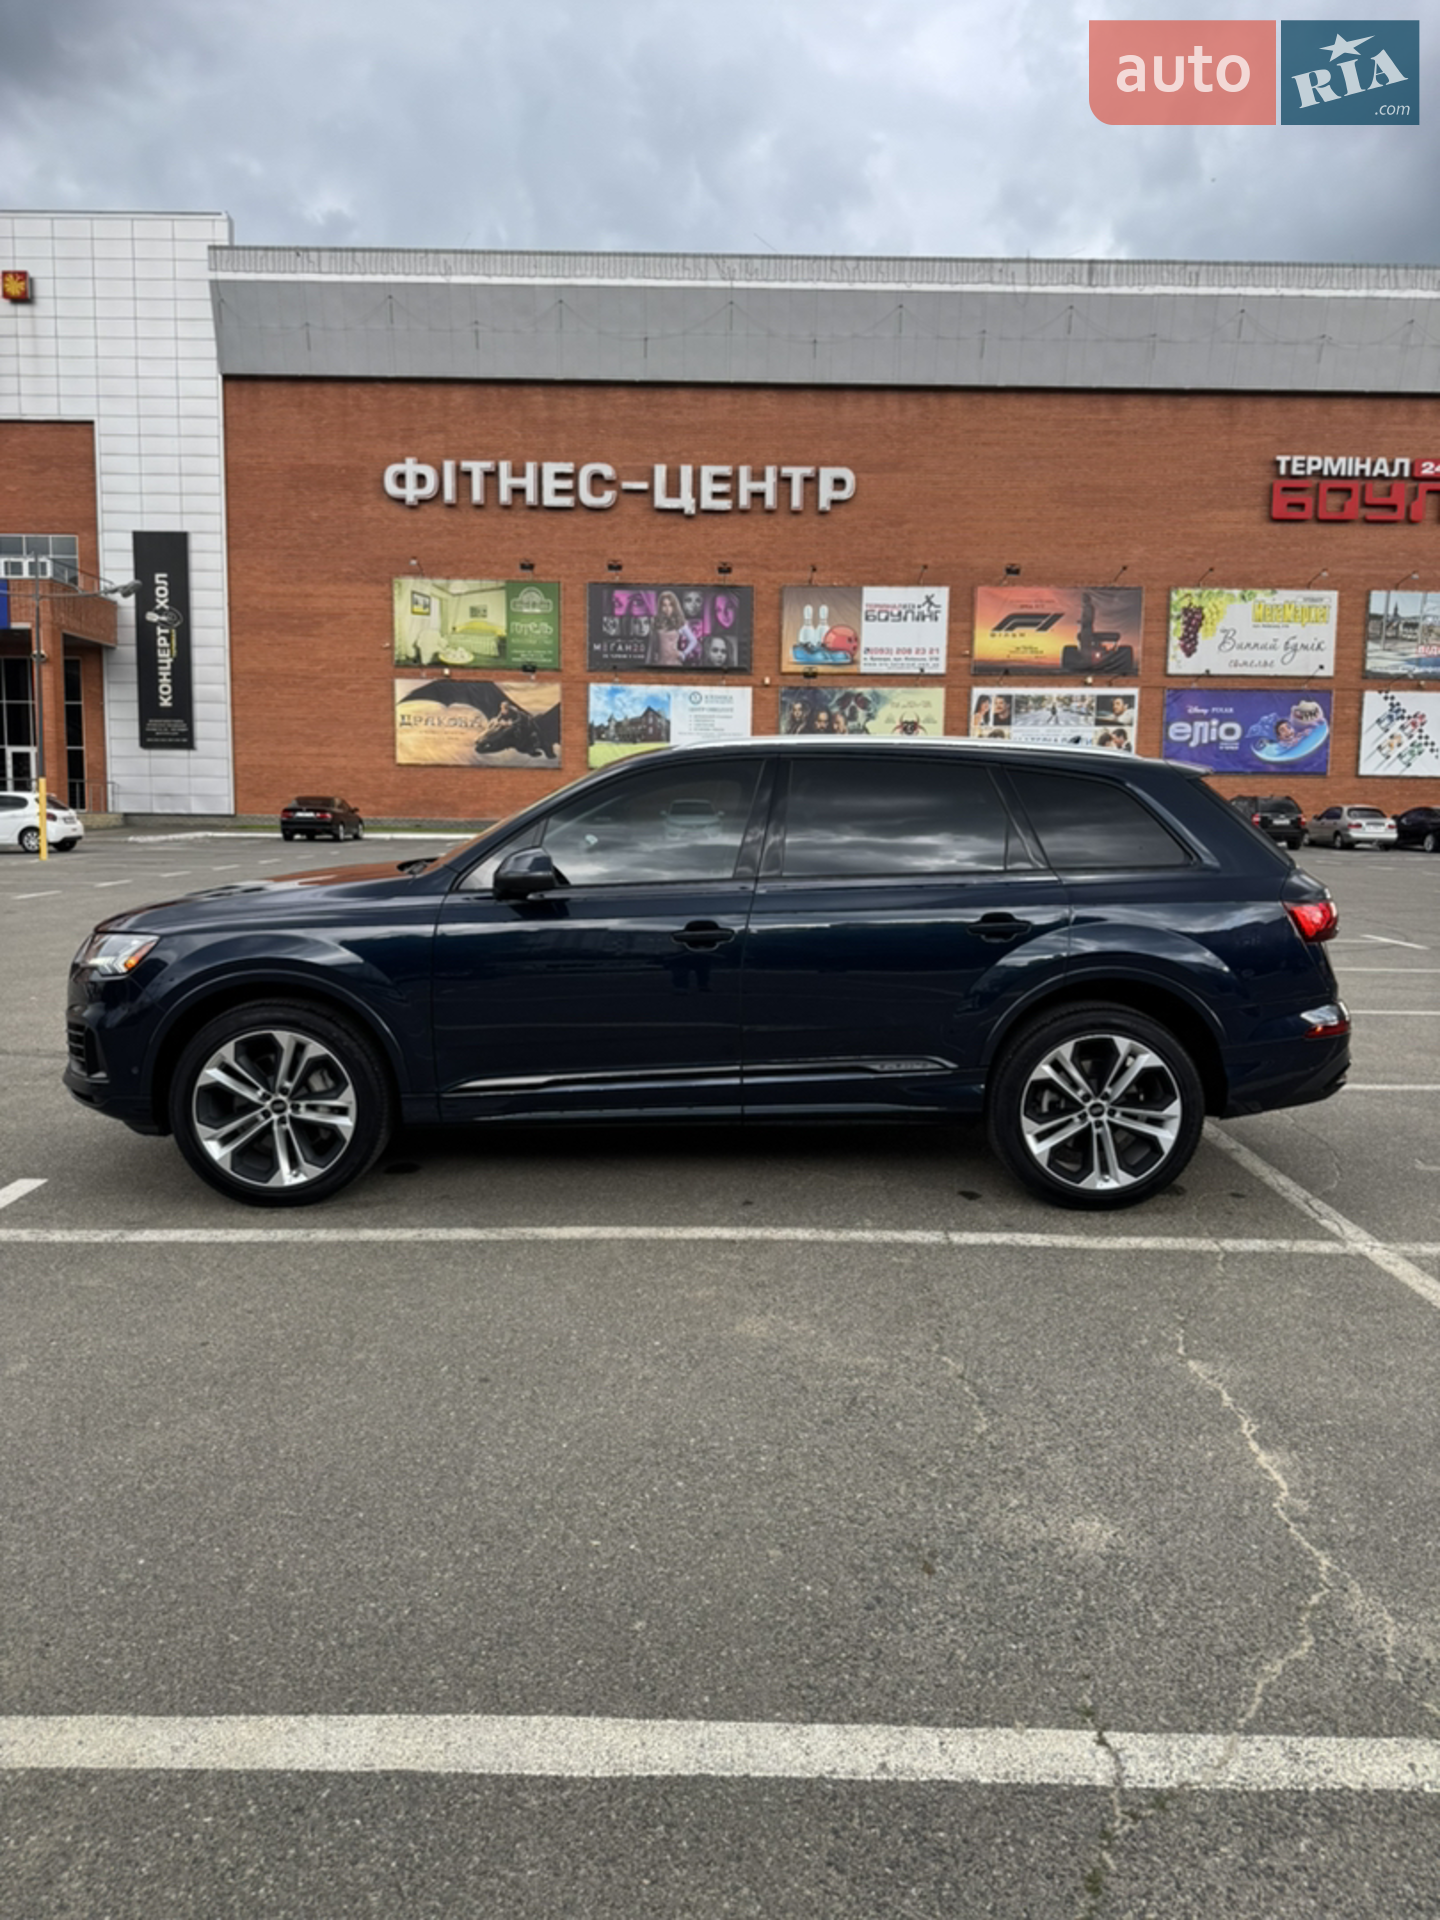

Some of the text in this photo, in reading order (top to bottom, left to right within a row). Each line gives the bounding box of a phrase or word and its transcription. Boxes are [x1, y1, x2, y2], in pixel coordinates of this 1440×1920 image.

[1275, 455, 1411, 478] ТЕРМІНАЛ
[383, 457, 857, 516] ФІТНЕС-ЦЕНТР
[154, 573, 170, 610] ХОЛ
[864, 609, 942, 622] БОУЛІНГ
[156, 625, 174, 707] КОНЦЕРТ
